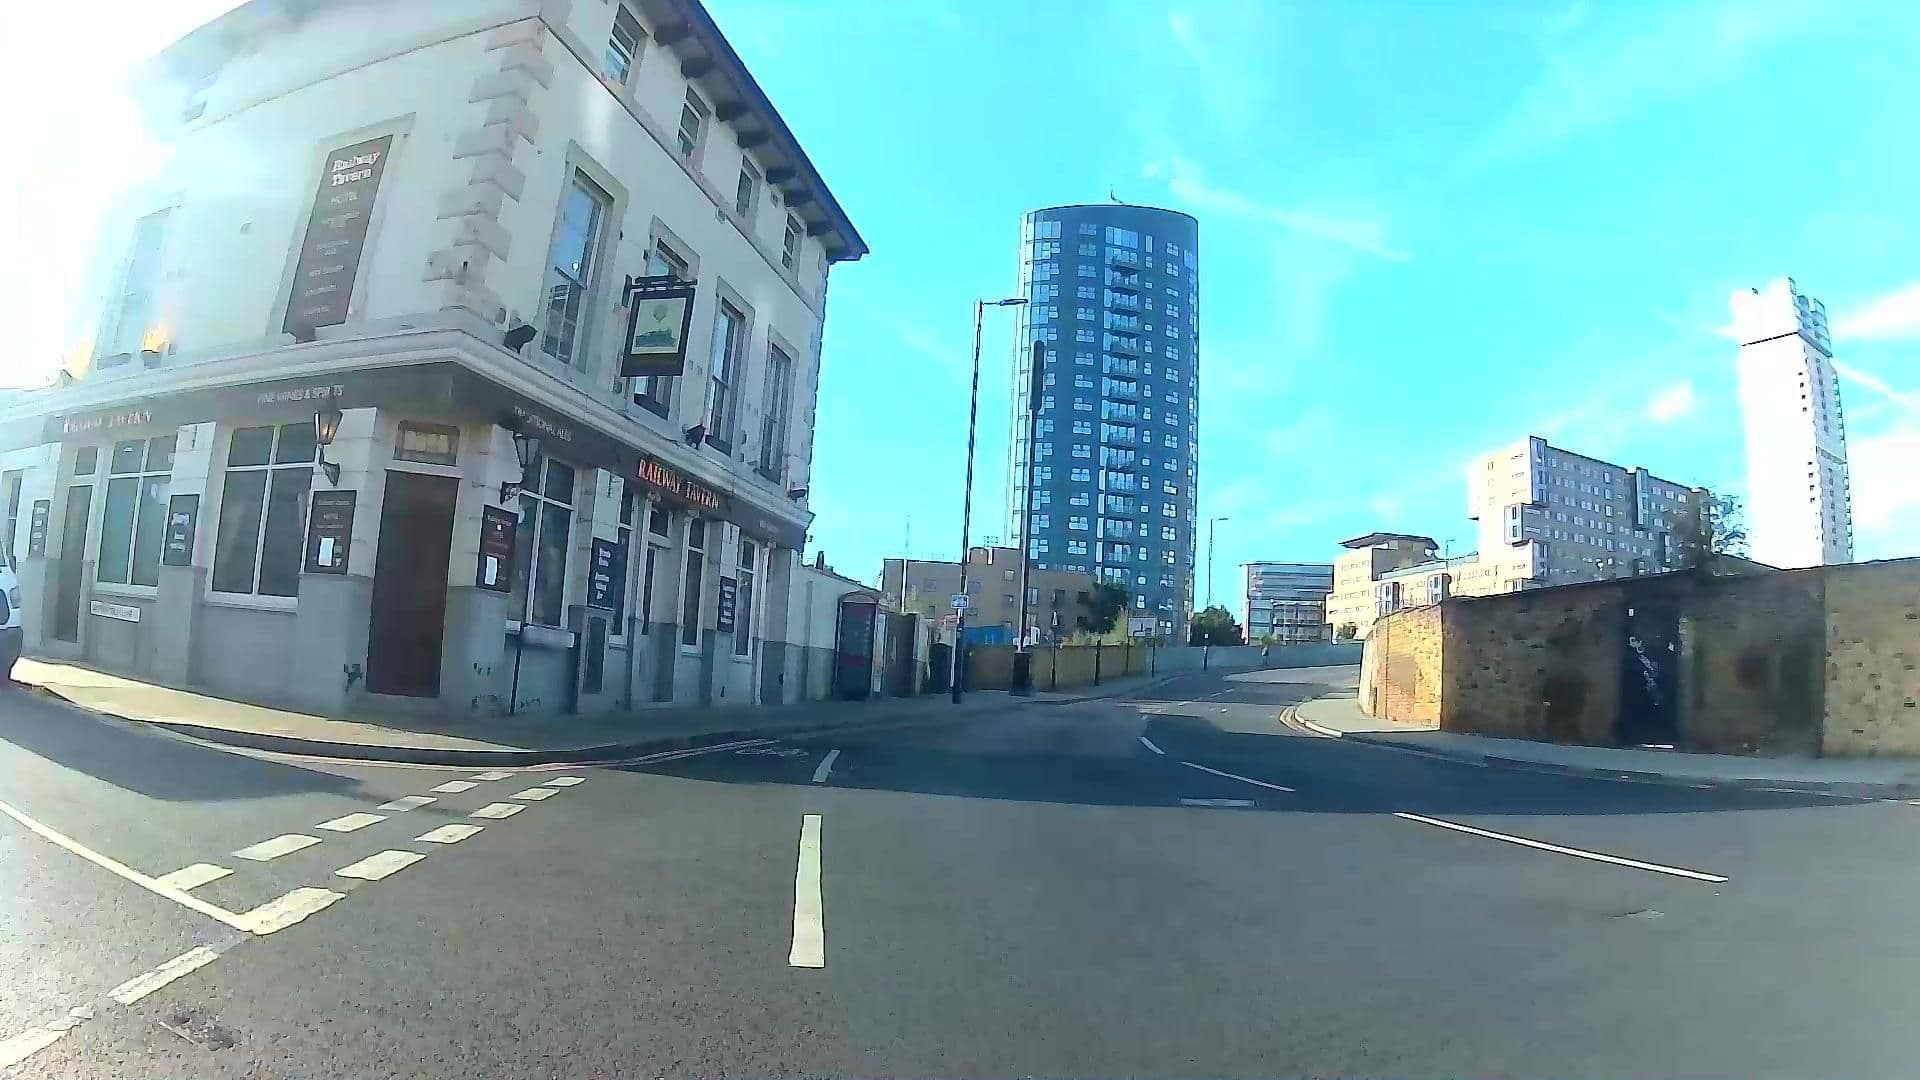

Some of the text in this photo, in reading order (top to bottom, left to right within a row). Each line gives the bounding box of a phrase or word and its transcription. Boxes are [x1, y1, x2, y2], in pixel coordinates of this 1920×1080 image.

[331, 151, 381, 173] Railway
[331, 168, 372, 187] Tavern
[311, 384, 344, 398] SPIRTS
[514, 405, 556, 436] TRATIONAL
[638, 458, 720, 511] RAILWAY TAVERN
